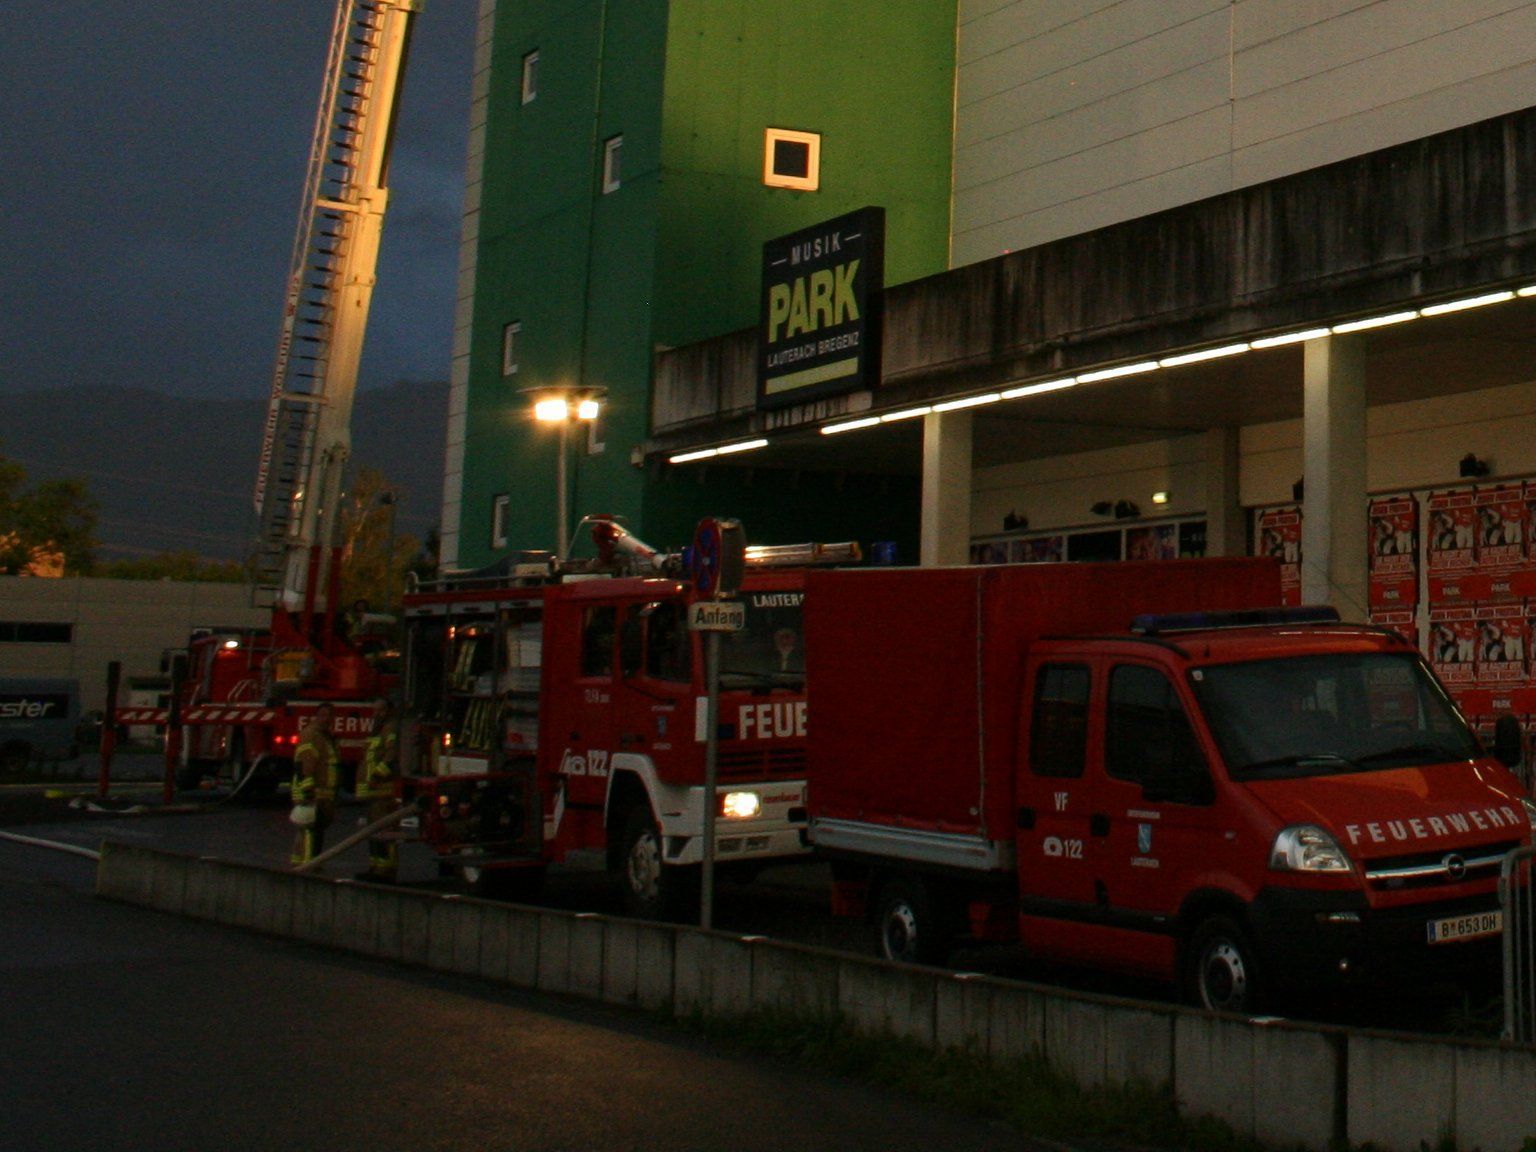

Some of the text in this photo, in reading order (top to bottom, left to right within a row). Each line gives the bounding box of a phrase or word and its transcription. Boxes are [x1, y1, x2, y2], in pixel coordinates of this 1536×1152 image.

[790, 231, 842, 266] MUSIK
[768, 258, 861, 344] PARK
[767, 330, 861, 369] LAUTERACH BREGENZ
[695, 607, 743, 628] Anfang
[1053, 791, 1070, 812] VF
[1344, 805, 1521, 846] FEUERWEHR
[1063, 838, 1084, 860] 122
